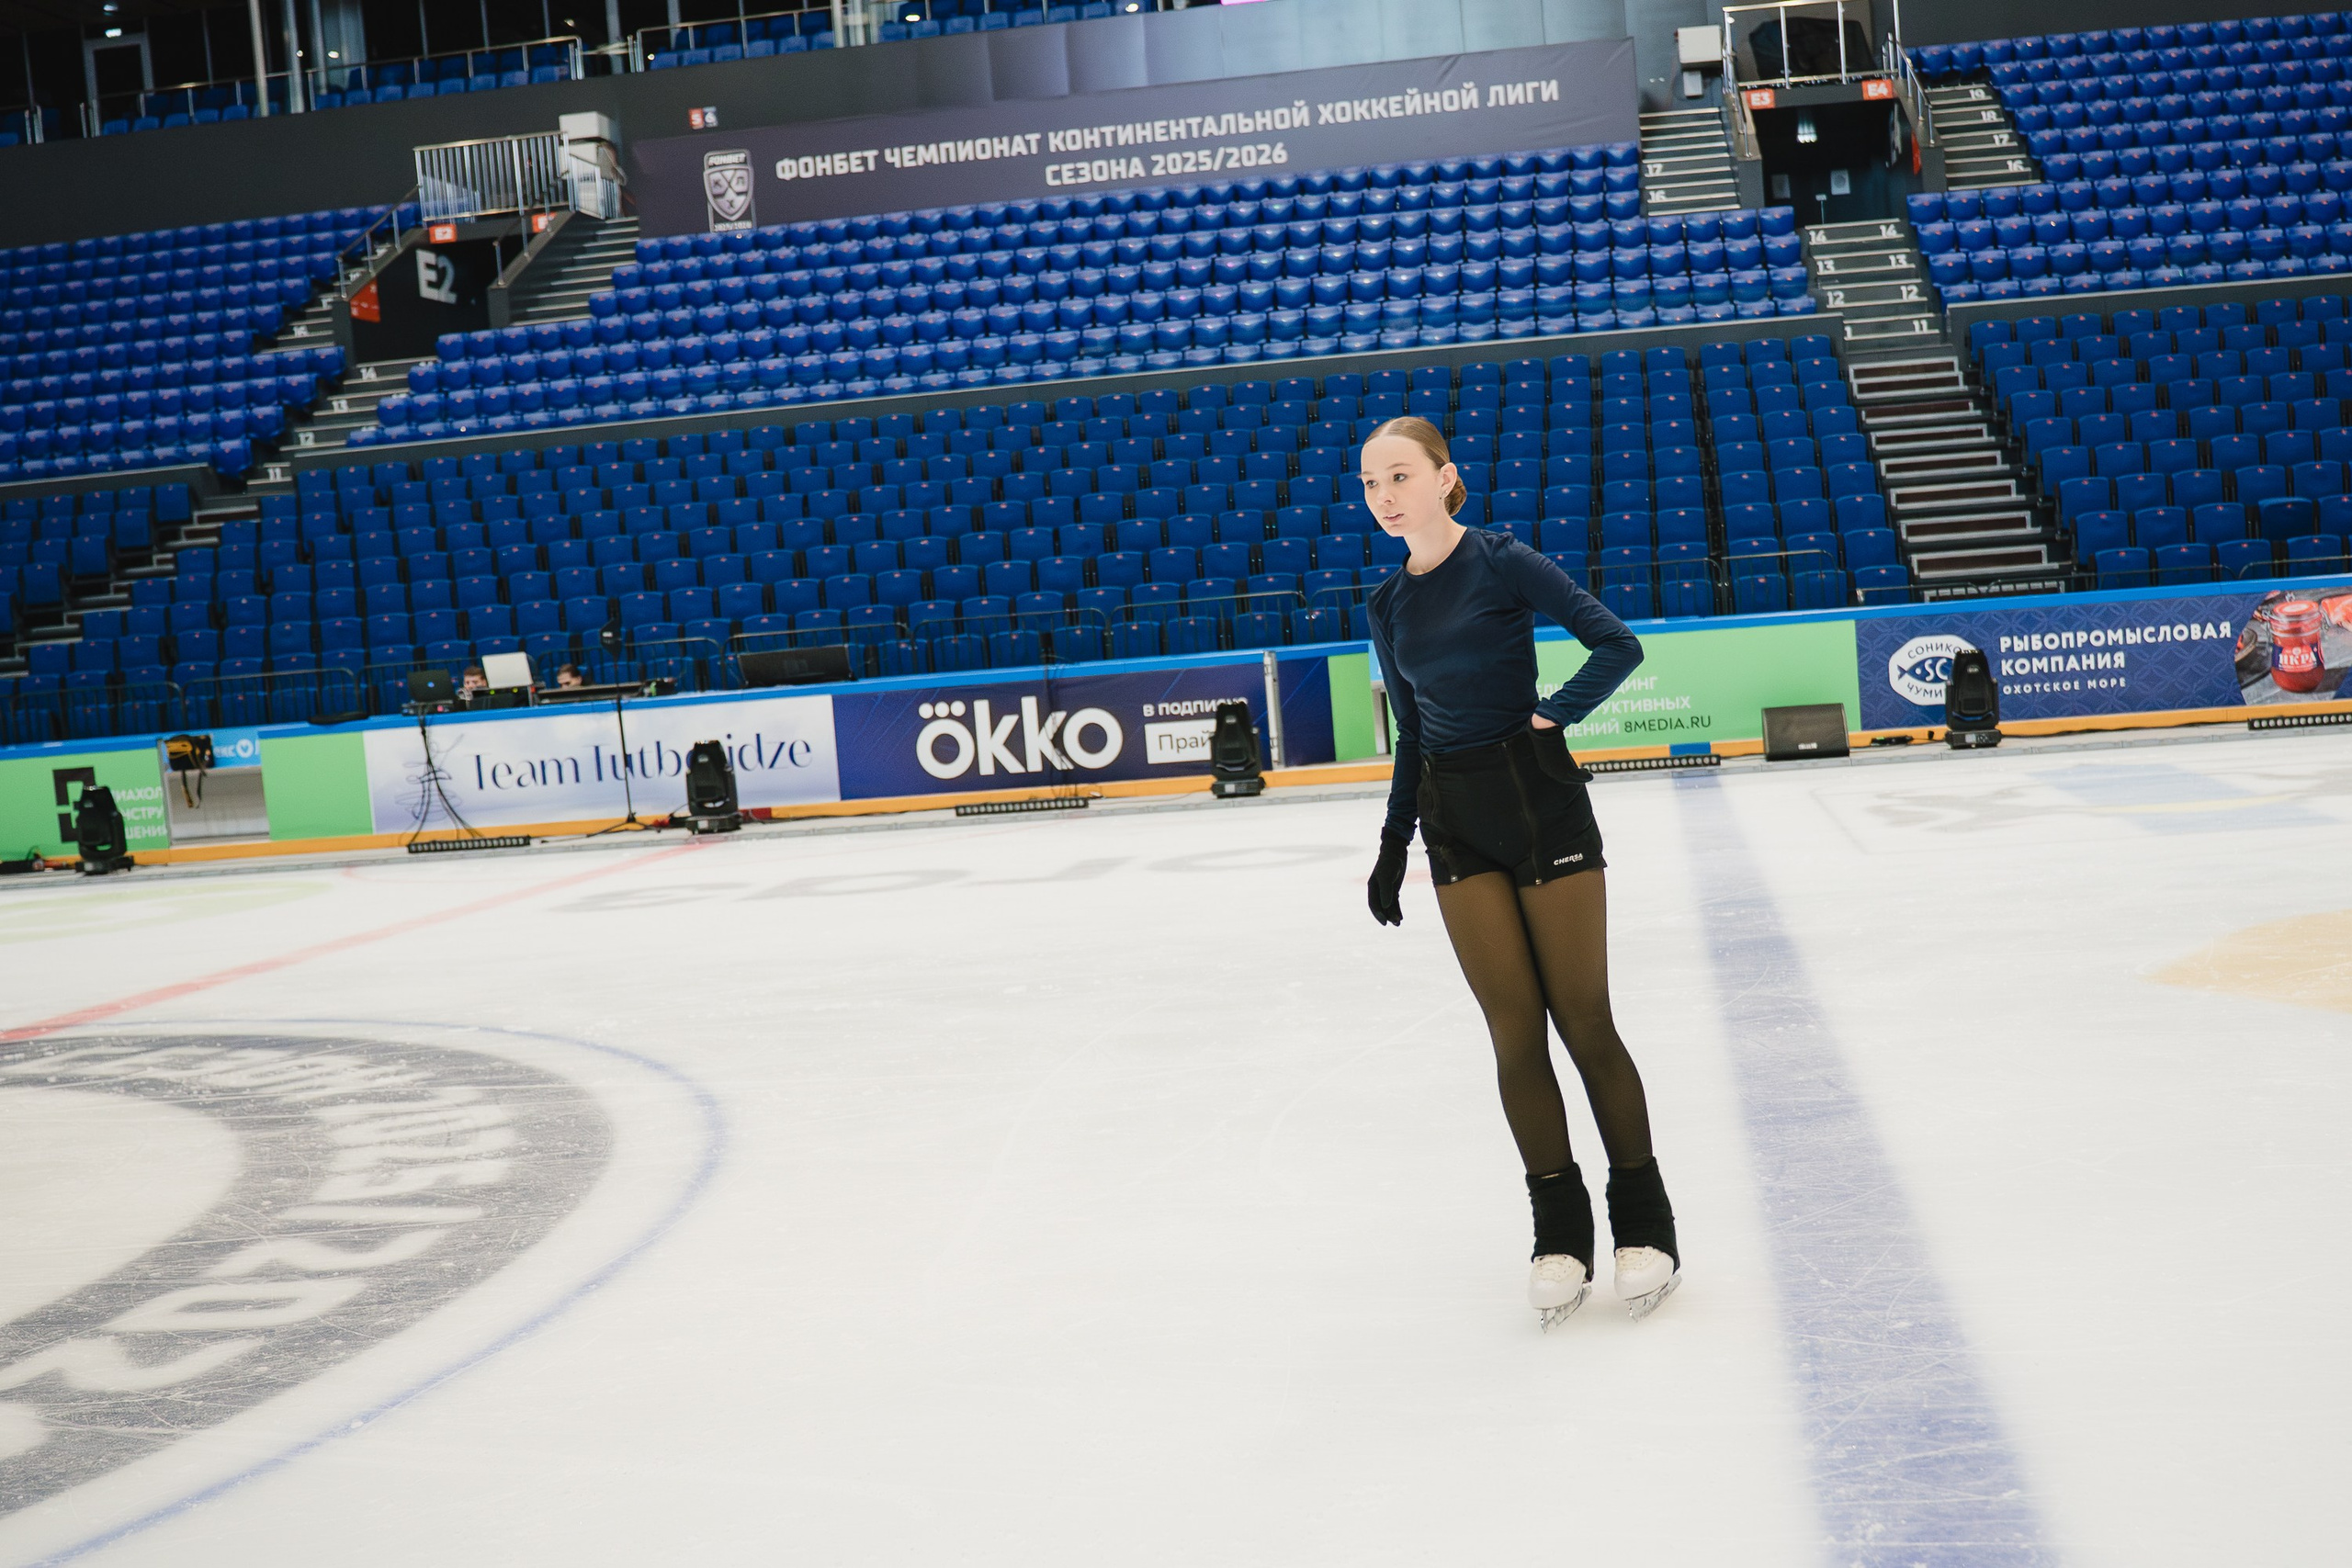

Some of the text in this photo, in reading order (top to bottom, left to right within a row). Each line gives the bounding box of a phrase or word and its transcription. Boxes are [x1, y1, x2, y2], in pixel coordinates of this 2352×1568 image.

[1869, 82, 1888, 97] E4
[1750, 93, 1770, 107] E3
[775, 79, 1559, 181] ФОНБЕТ ЧЕМПИОНАТ КОНТИНЕНТАЛЬНОЙ ХОККЕЙНОЙ ЛИГИ
[1046, 142, 1288, 186] СЕЗОНА 2025/2026
[1880, 224, 1897, 238] 14
[1816, 254, 1906, 273] 13 13
[415, 248, 458, 304] E2
[1827, 285, 1918, 307] 12 12
[1913, 320, 1928, 333] 11
[2000, 621, 2231, 653] РЫБОПРОМЫСЛОВАЯ
[2001, 651, 2125, 676] КОМПАНИЯ
[2003, 677, 2128, 695] ОХОТСКОЕ МОРЕ
[1624, 716, 1712, 734] 8MEDIA.RU
[464, 751, 582, 791] Team
